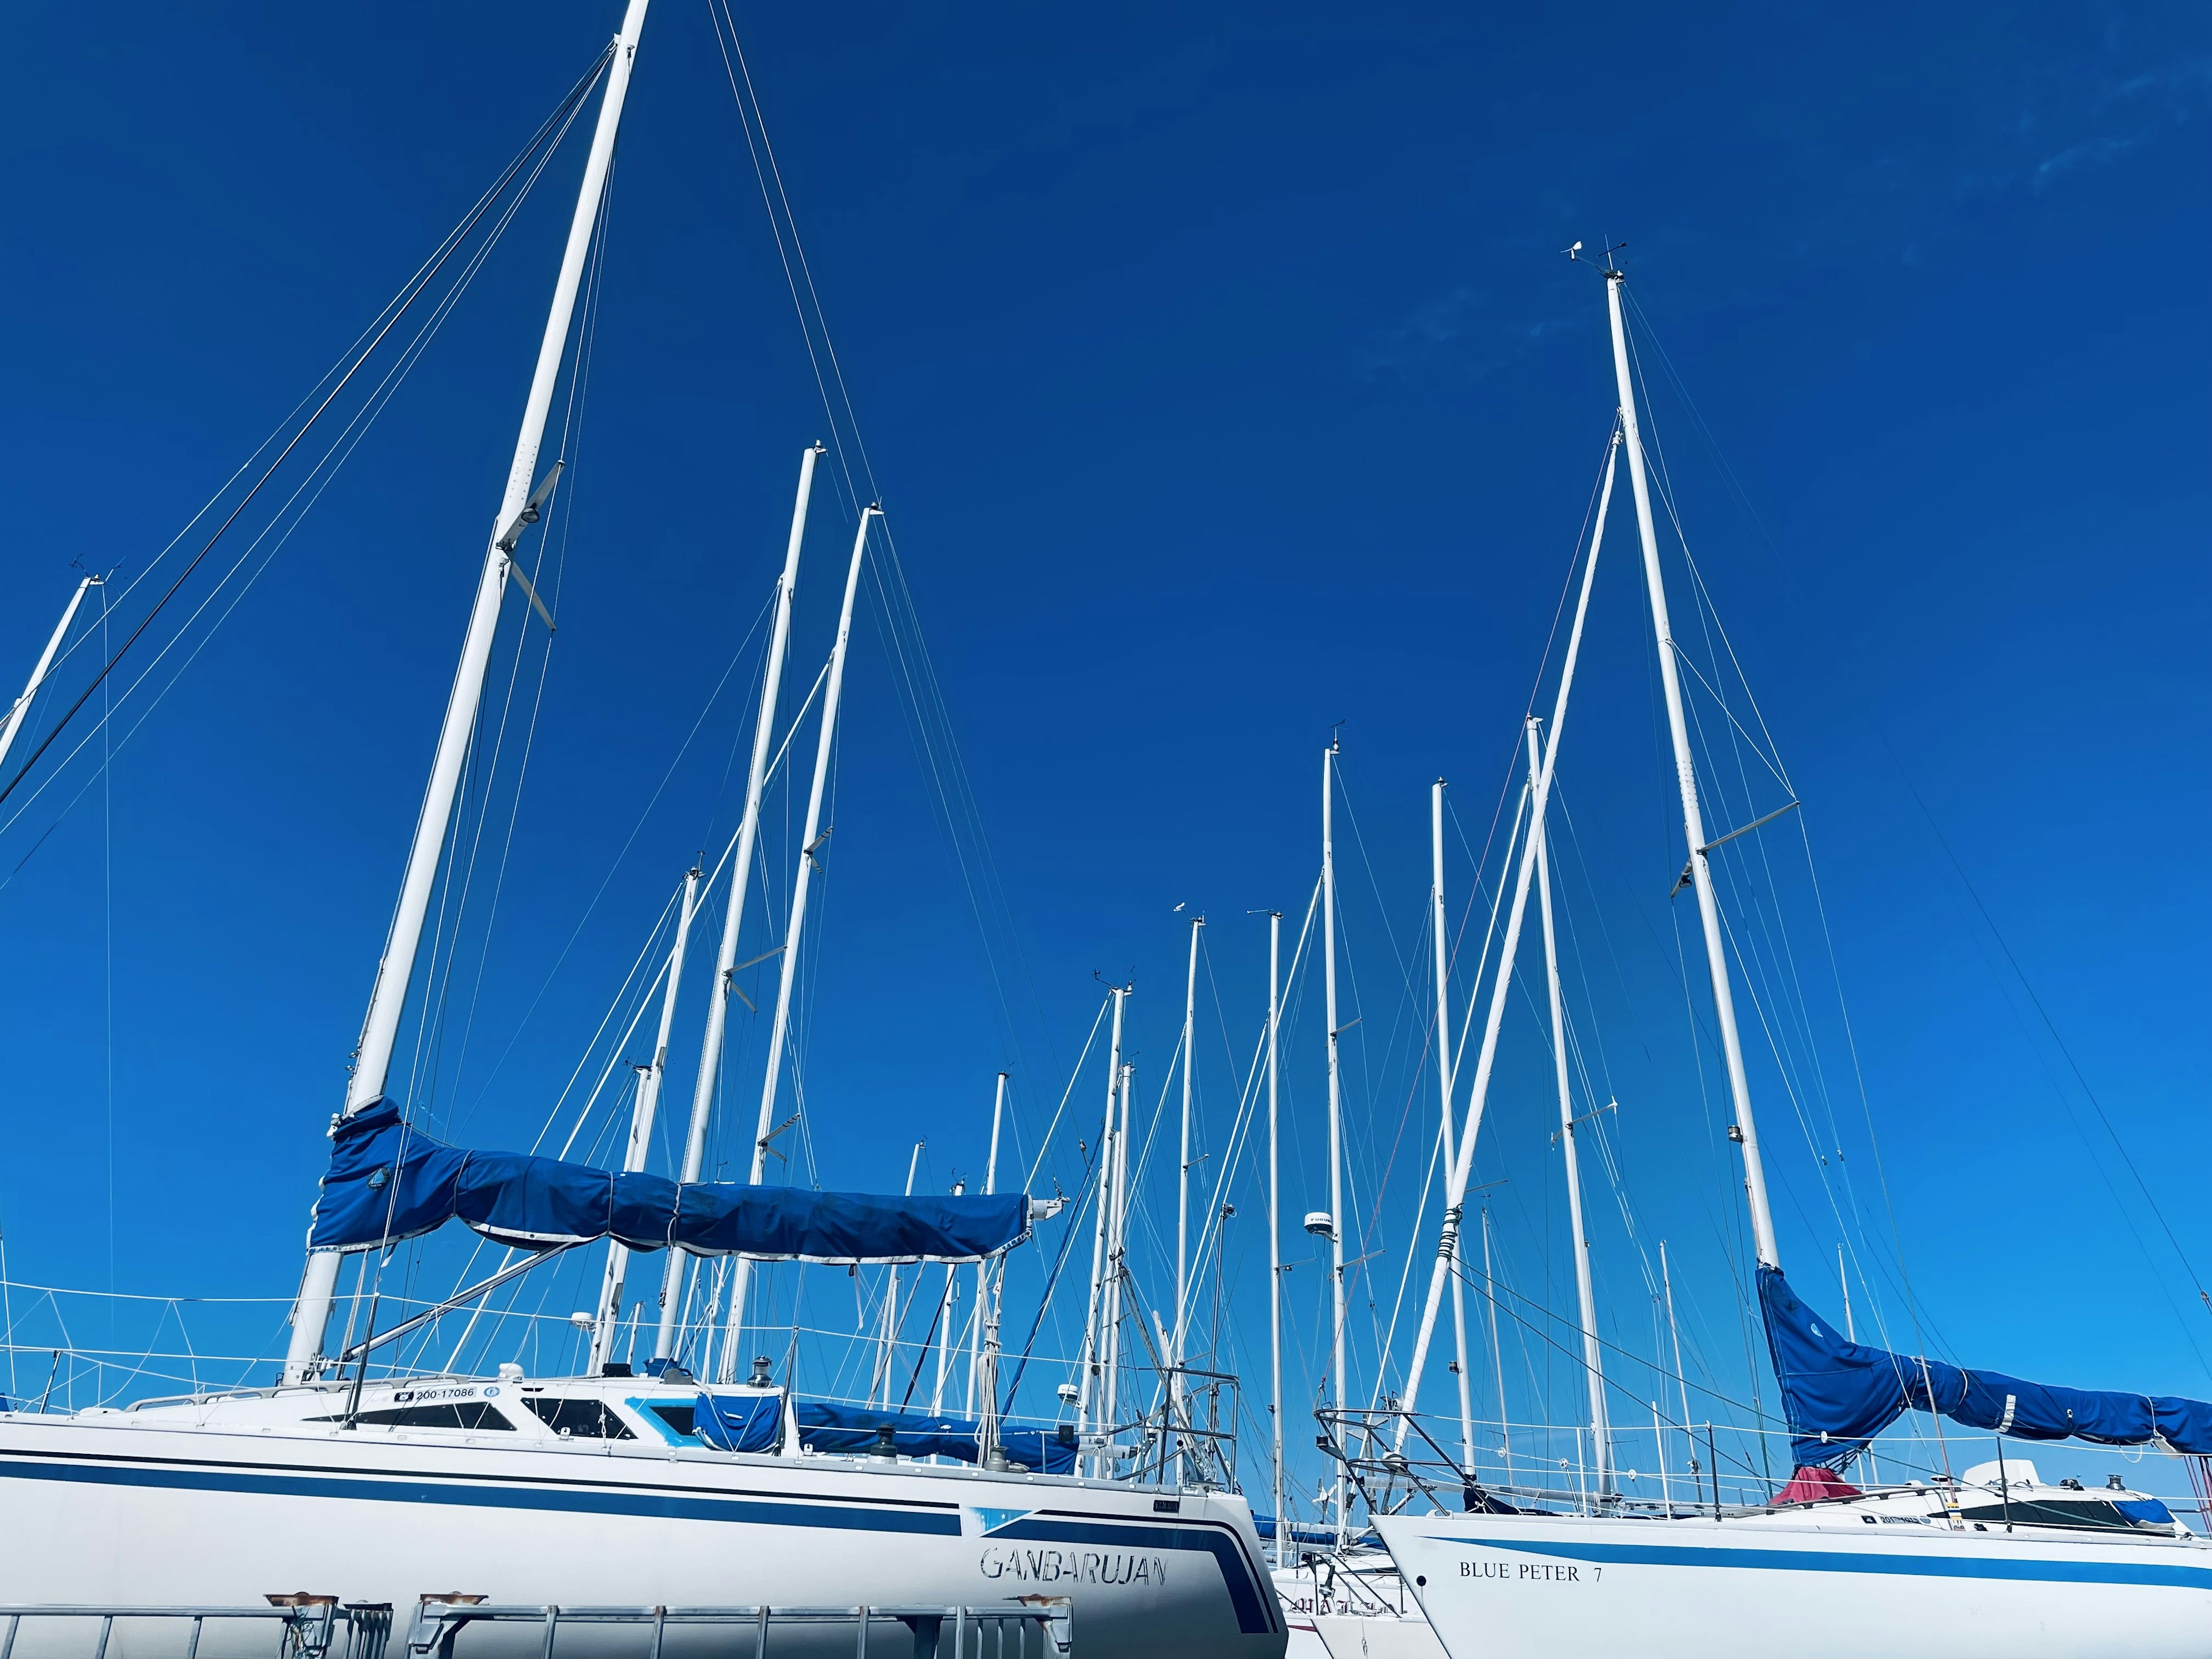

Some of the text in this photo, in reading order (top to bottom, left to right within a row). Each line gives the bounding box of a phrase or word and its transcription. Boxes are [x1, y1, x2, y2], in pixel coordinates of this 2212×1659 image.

[416, 1388, 474, 1400] 200-17086
[980, 1547, 1169, 1585] GANBARUJAN
[1460, 1562, 1601, 1582] BLUE PETER 7
